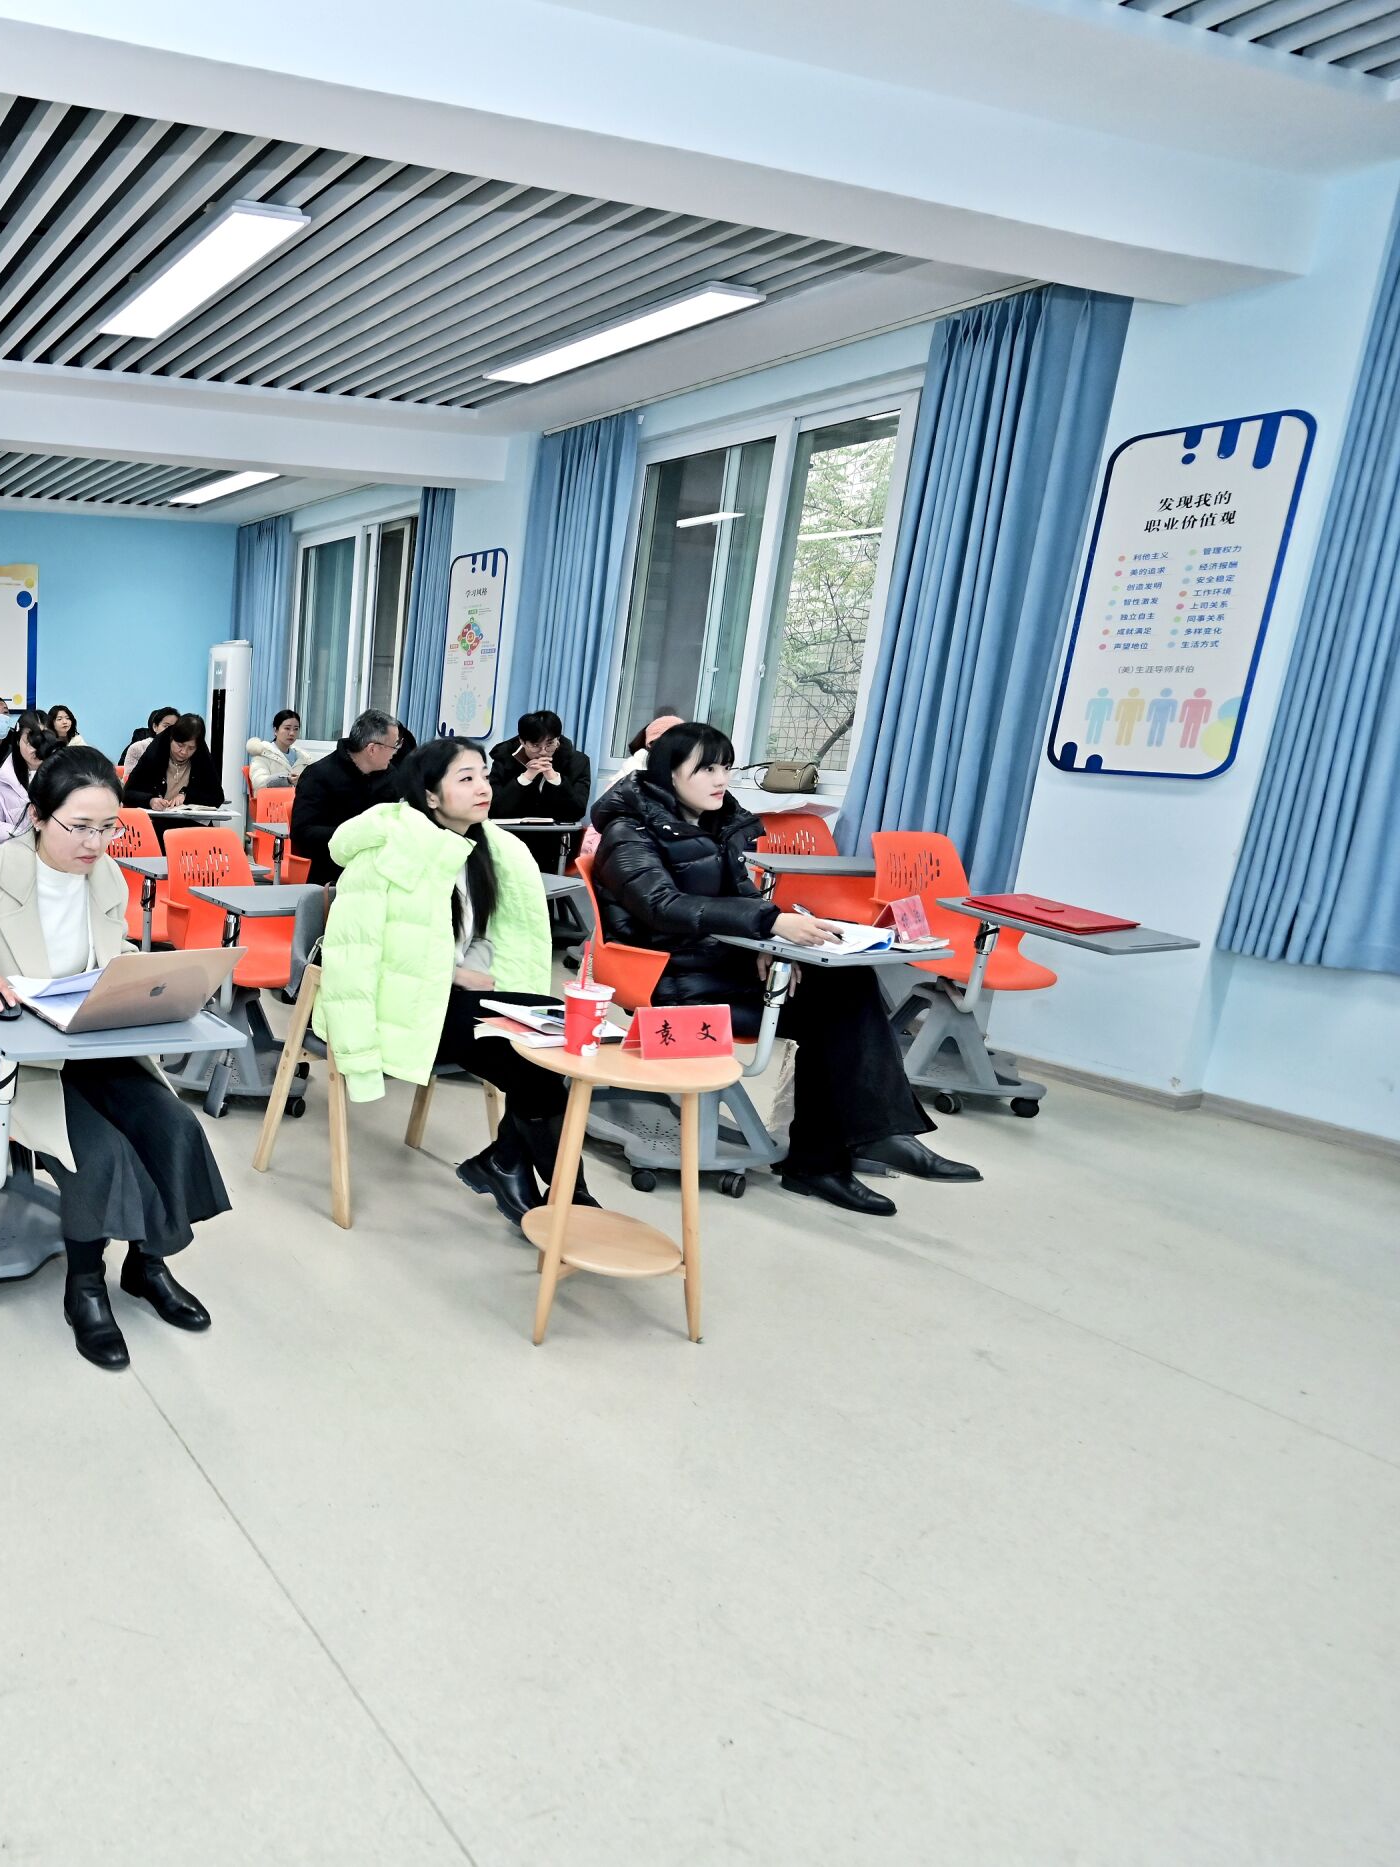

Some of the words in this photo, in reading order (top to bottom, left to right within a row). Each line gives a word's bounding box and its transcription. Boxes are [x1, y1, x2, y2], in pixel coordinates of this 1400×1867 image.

[1158, 490, 1232, 512] 发现我的
[1144, 510, 1237, 533] 职业价值观
[1133, 551, 1169, 560] 利他主义
[1180, 640, 1220, 649] 生活方式
[655, 1019, 717, 1046] 袁文
